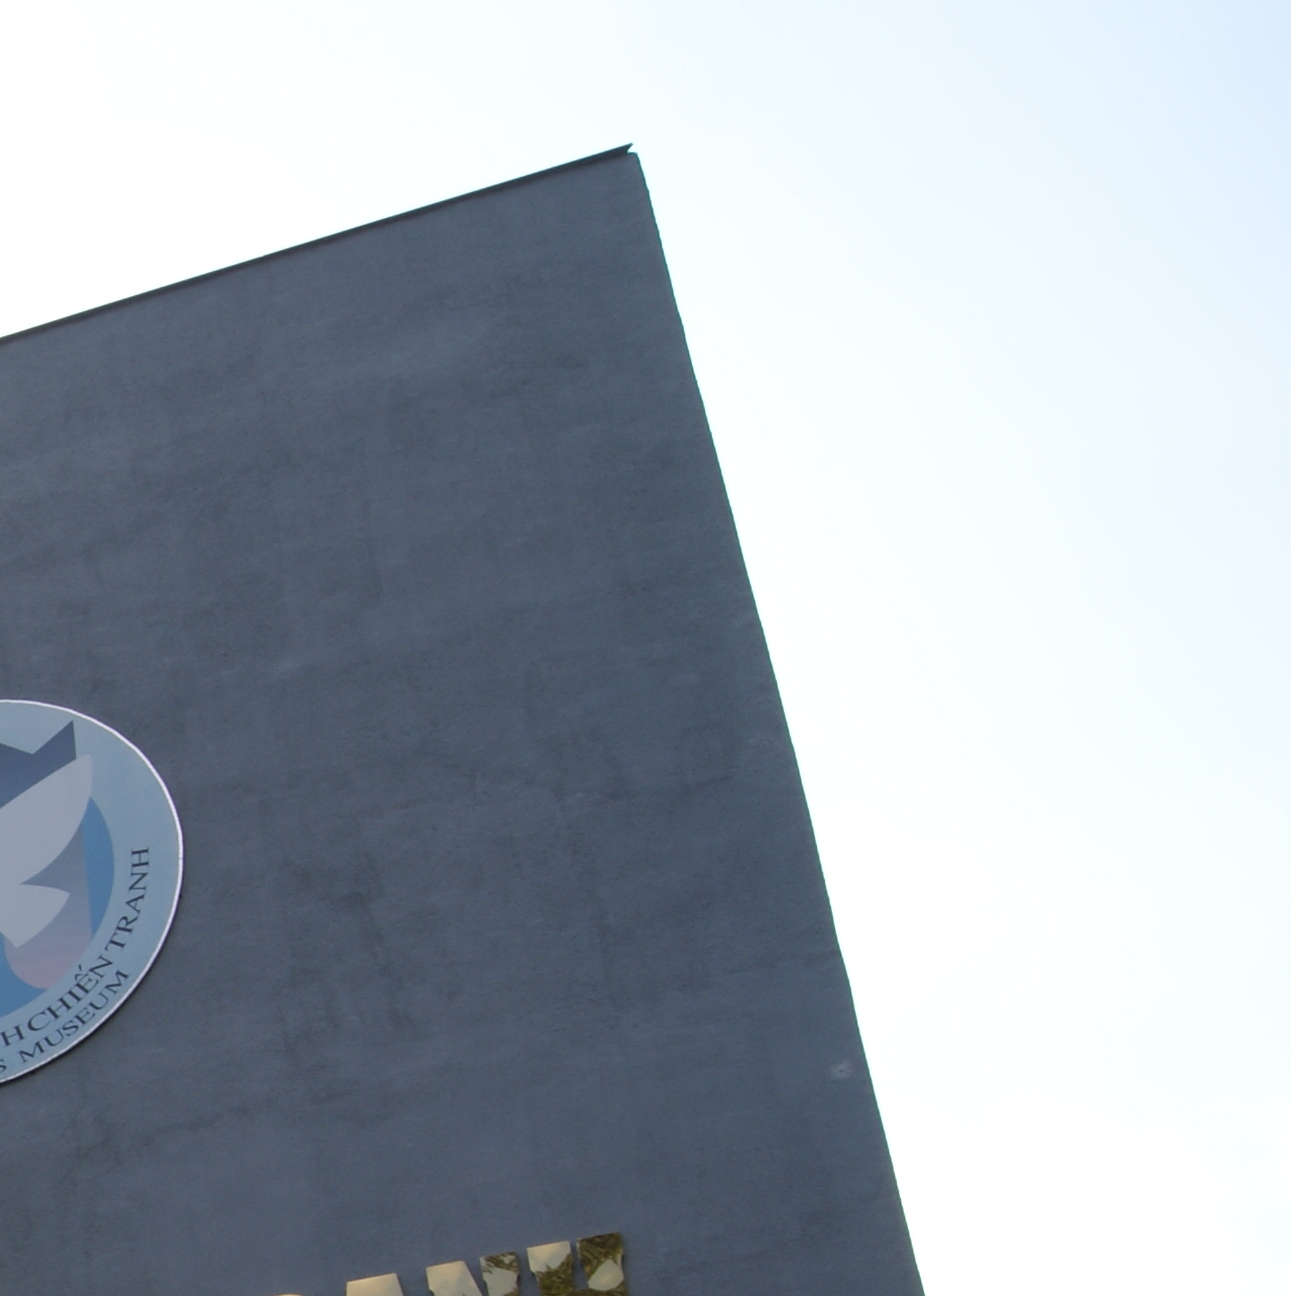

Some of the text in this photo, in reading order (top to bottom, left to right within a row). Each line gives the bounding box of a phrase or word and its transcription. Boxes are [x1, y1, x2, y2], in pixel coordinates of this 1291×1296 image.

[27, 956, 113, 1031] CHIẾN
[105, 848, 149, 953] TRANH
[19, 970, 129, 1063] MUSEUM
